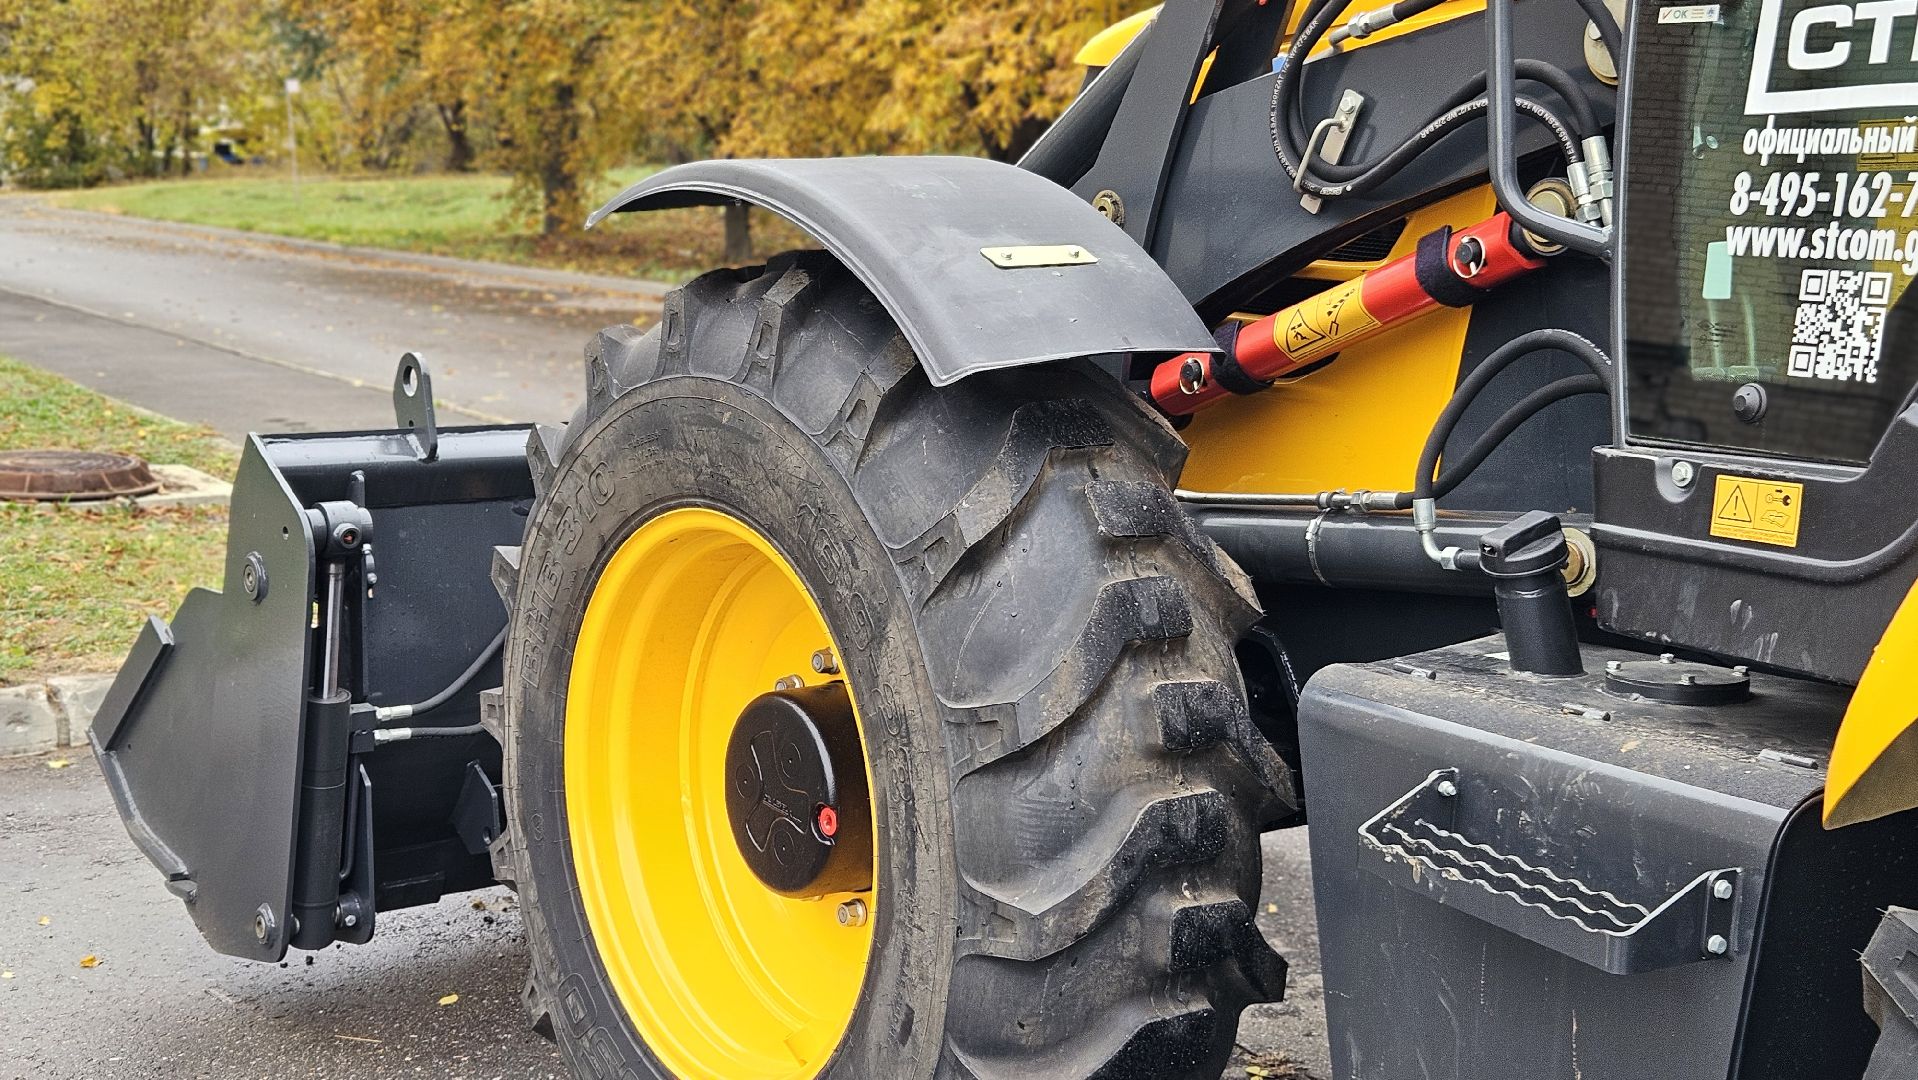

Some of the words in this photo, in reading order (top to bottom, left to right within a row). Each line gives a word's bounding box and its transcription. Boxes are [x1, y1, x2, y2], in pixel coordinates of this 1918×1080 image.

[1306, 20, 1320, 36] BAR
[1673, 10, 1688, 19] OK
[1788, 0, 1918, 71] СТ
[1743, 114, 1917, 166] официальный
[555, 460, 616, 556] 310
